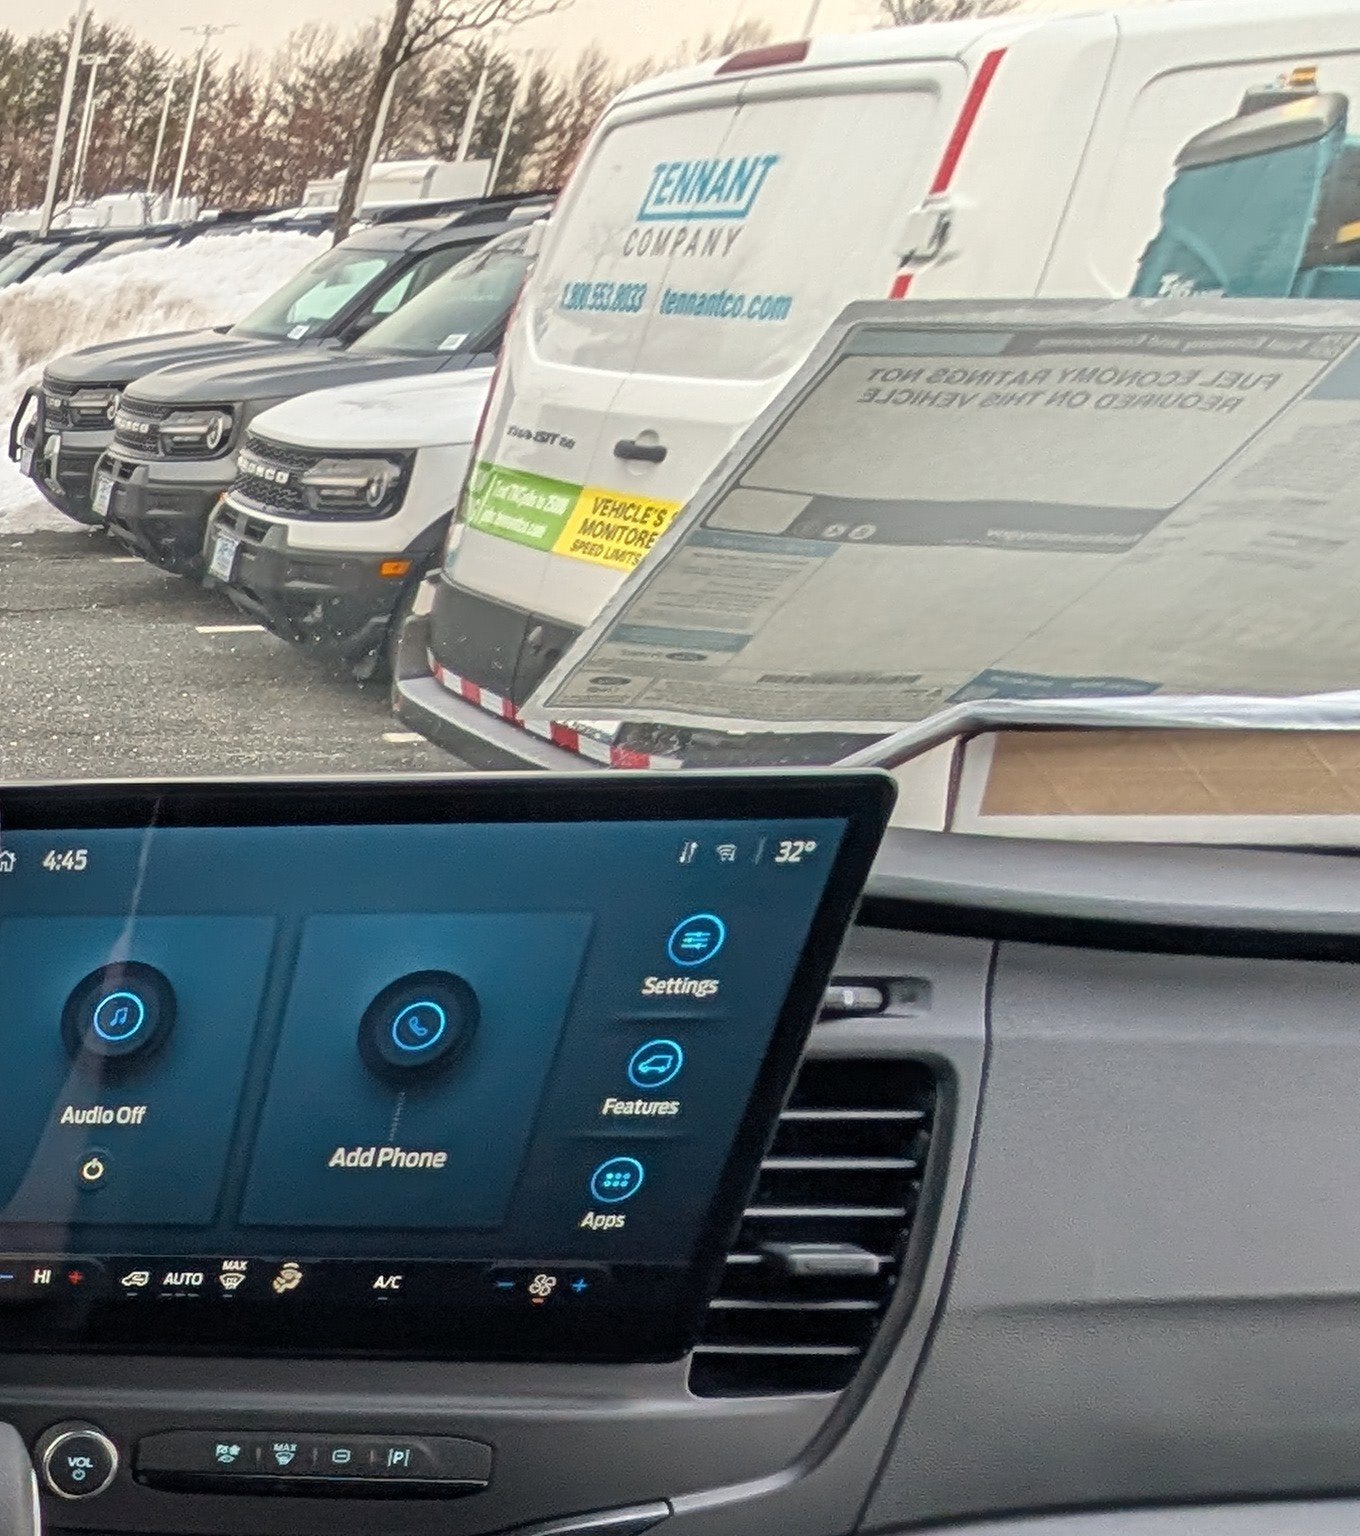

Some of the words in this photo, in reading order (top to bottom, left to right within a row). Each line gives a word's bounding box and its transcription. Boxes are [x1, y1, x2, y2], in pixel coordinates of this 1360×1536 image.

[637, 154, 780, 222] TENNANT
[622, 226, 746, 258] COMPANY
[659, 287, 794, 321] tennantco.com
[590, 495, 669, 528] VEHICLE'S
[577, 517, 662, 550] MONITORE
[569, 538, 603, 558] SPEED
[42, 849, 88, 872] 4:45
[774, 840, 818, 863] 32°
[641, 975, 720, 999] Settings
[60, 1105, 115, 1126] Audio
[116, 1105, 148, 1126] Off
[601, 1097, 681, 1117] Features
[328, 1147, 377, 1169] Add
[376, 1147, 449, 1169] Phone
[579, 1211, 627, 1232] Apps
[32, 1268, 52, 1285] HI
[221, 1260, 249, 1272] MAX
[162, 1272, 204, 1287] AUTO
[372, 1274, 404, 1291] A/C
[272, 1443, 298, 1452] MAX
[67, 1456, 94, 1469] VOL
